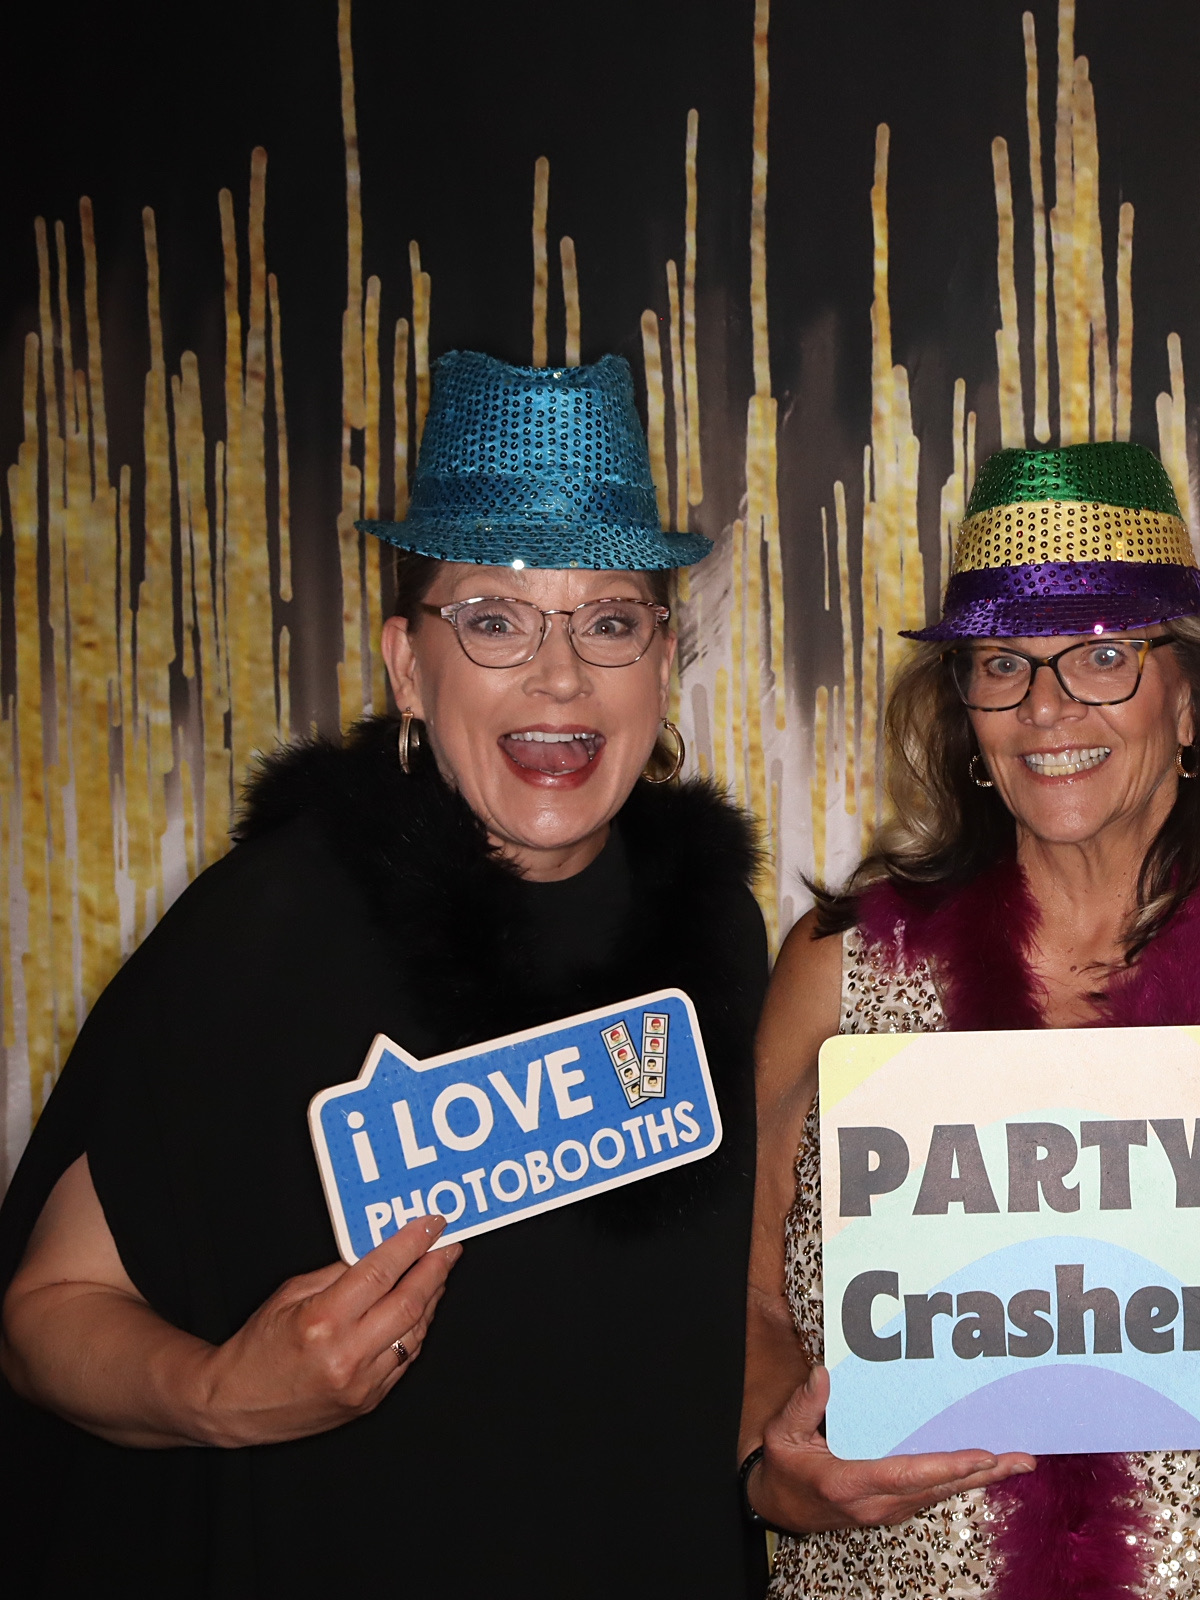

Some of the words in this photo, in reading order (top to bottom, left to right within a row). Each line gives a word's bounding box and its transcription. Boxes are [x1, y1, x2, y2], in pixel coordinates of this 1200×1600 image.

[347, 1111, 380, 1183] i
[392, 1046, 594, 1169] LOVE
[364, 1101, 701, 1248] PHOTOBOOTHS
